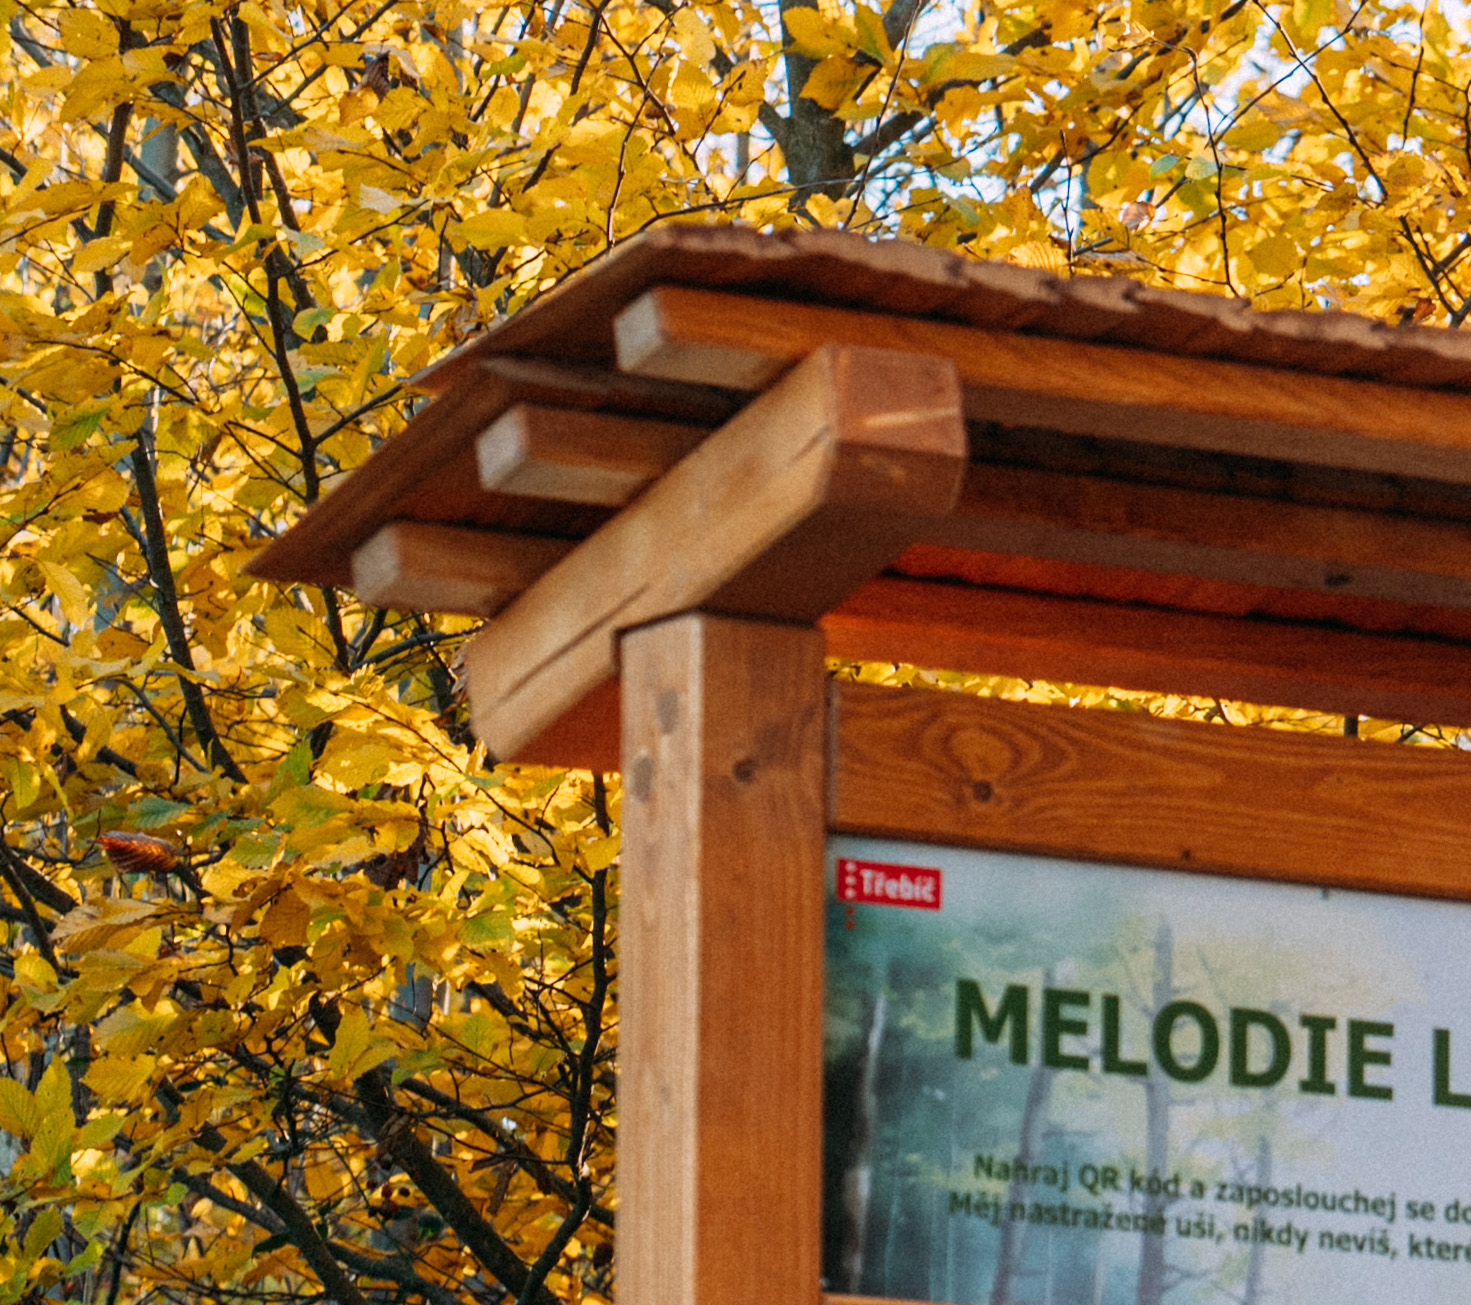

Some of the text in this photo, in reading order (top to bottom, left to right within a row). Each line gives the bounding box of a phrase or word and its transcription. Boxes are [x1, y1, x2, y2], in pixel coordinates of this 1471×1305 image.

[860, 868, 936, 903] Třebíč
[954, 978, 1395, 1101] MELODIE
[973, 1154, 1070, 1193] Nahraj
[1078, 1163, 1119, 1194] QR
[1129, 1169, 1180, 1198] kód
[1190, 1179, 1205, 1199] a
[1215, 1182, 1398, 1224] zaposlouchej
[1405, 1200, 1436, 1222] se
[950, 1190, 1000, 1226] Měj
[1009, 1199, 1166, 1236] nastražené
[1175, 1210, 1225, 1245] uši,
[1232, 1216, 1310, 1254] nikdy
[1318, 1226, 1398, 1260] nevíš,
